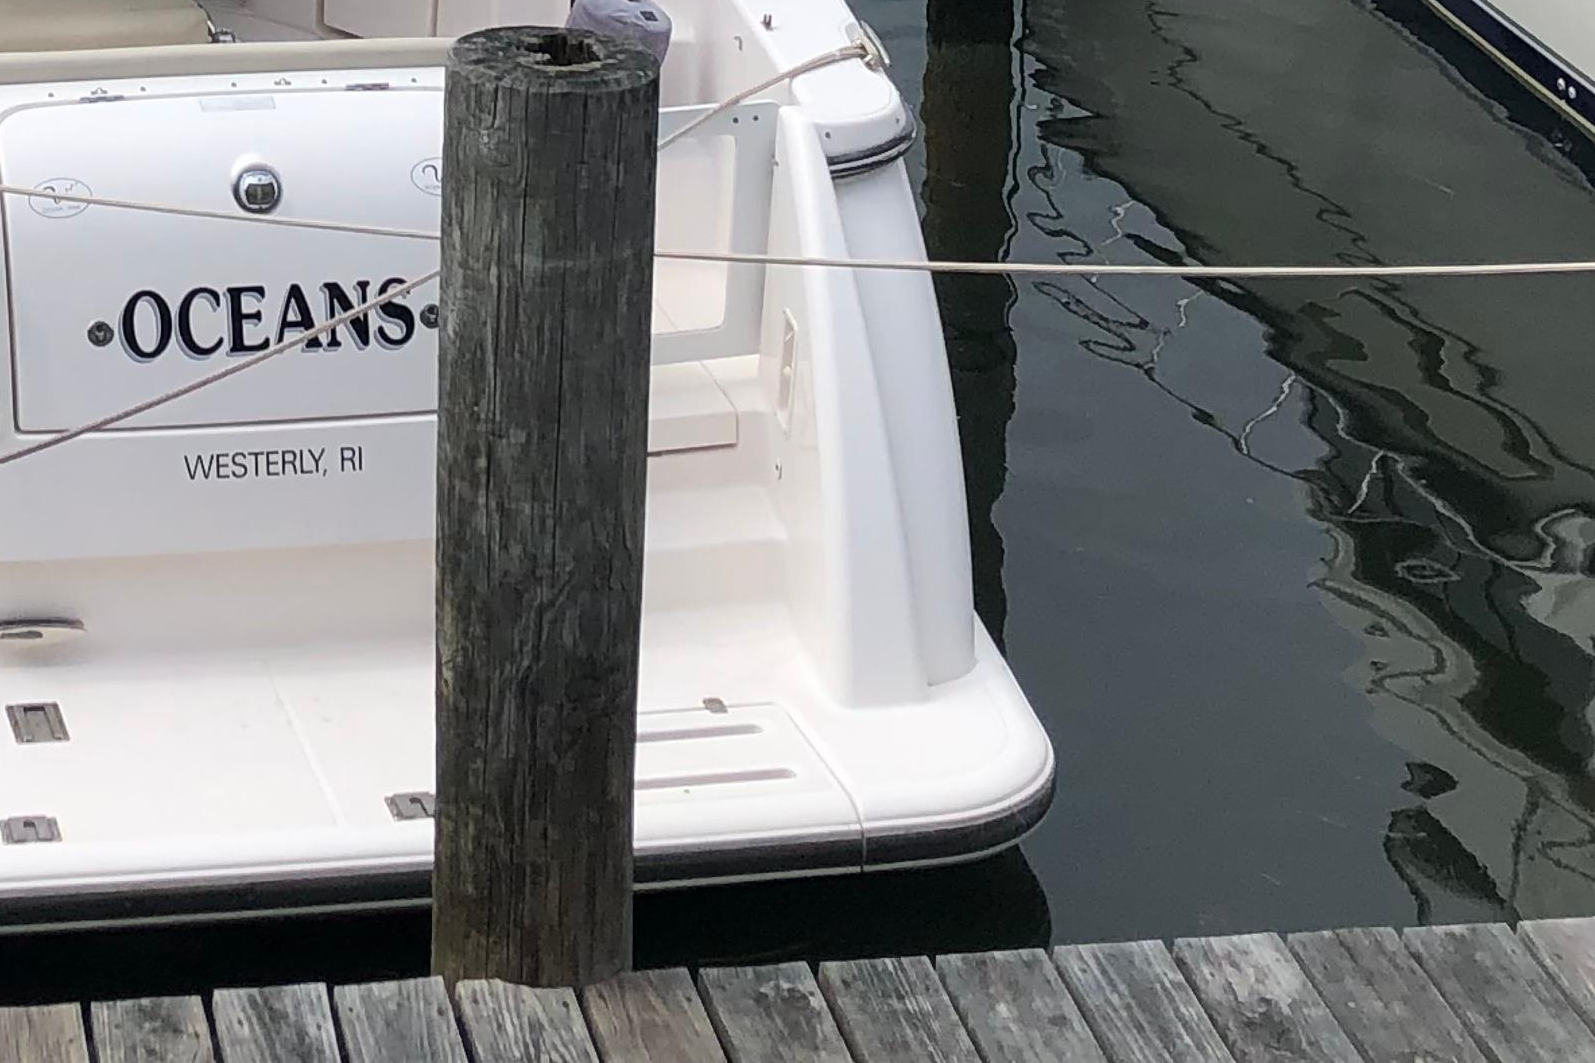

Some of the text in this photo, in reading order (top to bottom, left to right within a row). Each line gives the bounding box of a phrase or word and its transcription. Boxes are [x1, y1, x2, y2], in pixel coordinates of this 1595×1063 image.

[119, 278, 416, 362] OCEANS
[184, 446, 364, 480] WESTERLY, RI
